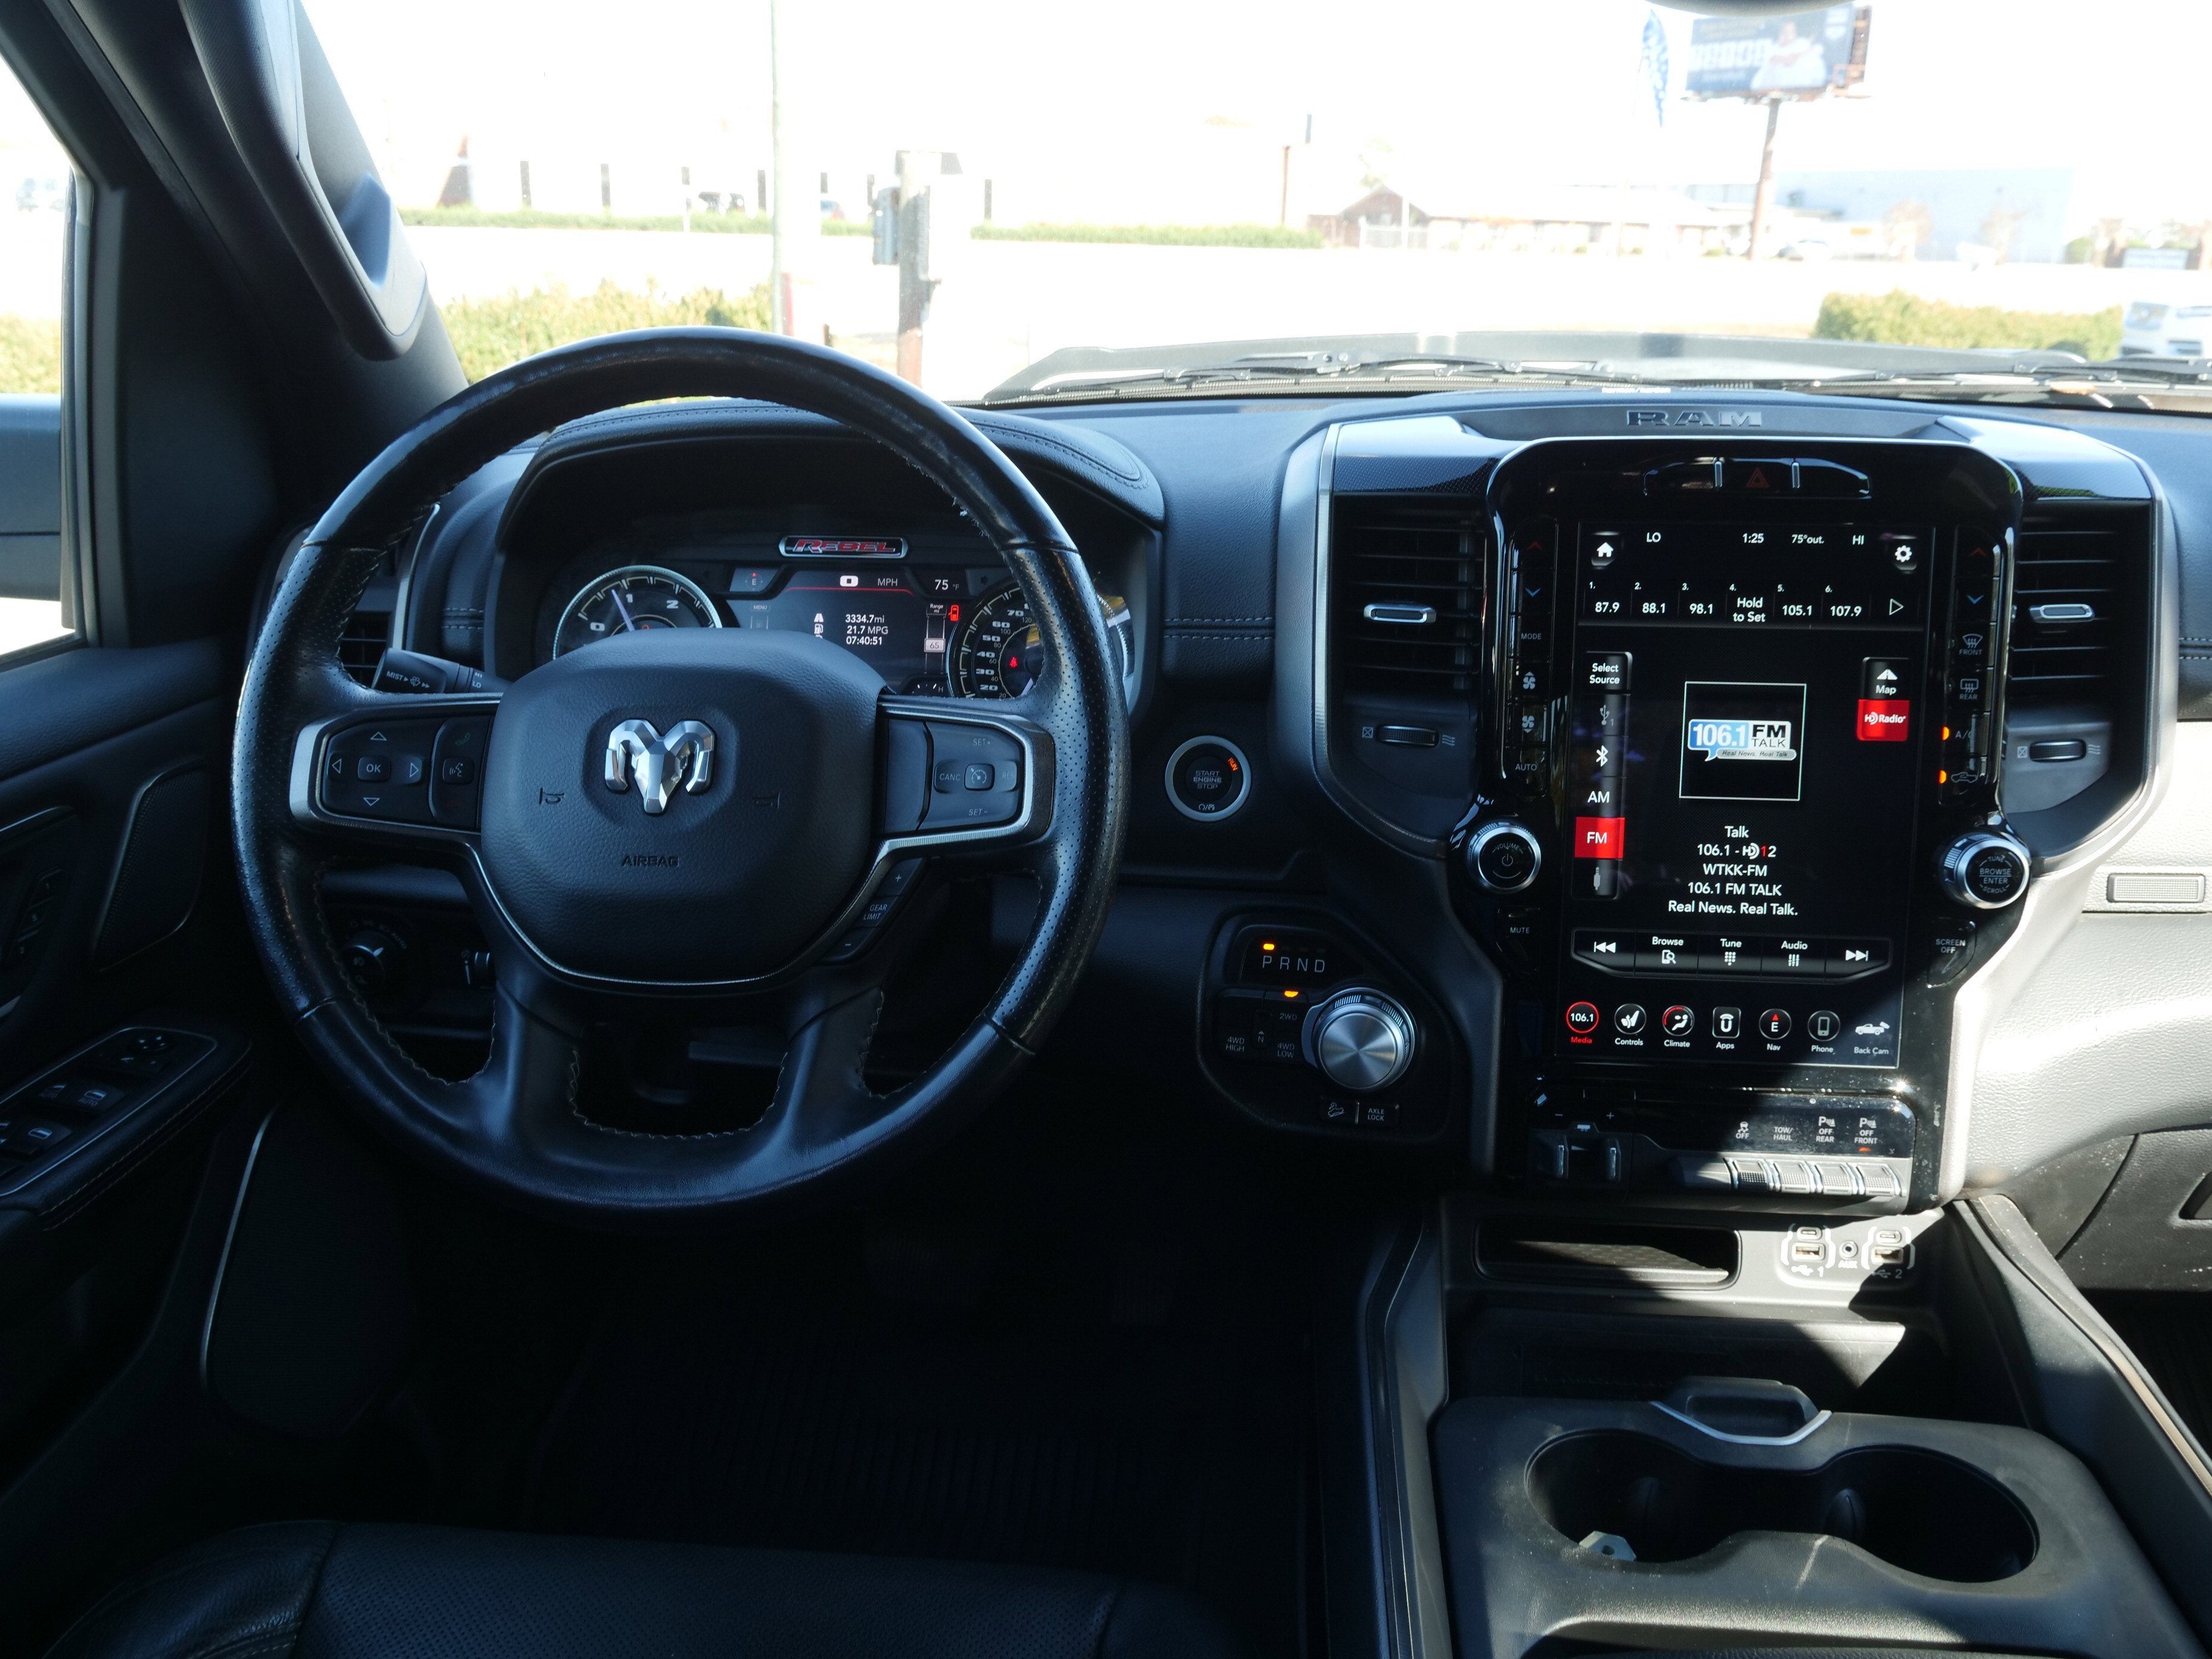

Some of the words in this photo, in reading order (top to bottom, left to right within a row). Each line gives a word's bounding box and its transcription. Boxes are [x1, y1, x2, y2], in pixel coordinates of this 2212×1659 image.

[1627, 410, 1762, 426] RAM
[1646, 532, 1661, 543] LO
[1742, 533, 1764, 543] 1:25
[1852, 535, 1865, 545] HI
[793, 539, 896, 554] REBEL
[877, 577, 898, 587] MPH
[934, 579, 949, 591] 75
[626, 594, 633, 603] 1
[1737, 597, 1763, 608] Hold
[666, 599, 679, 609] 2
[1595, 602, 1620, 613] 87.9
[1642, 602, 1666, 613] 88.1
[1689, 604, 1713, 614] 98.1
[1782, 605, 1812, 616] 105.1
[1830, 605, 1862, 617] 107.9
[1733, 612, 1745, 622] to
[1747, 611, 1766, 622] Set
[847, 626, 865, 634] 21.7
[867, 626, 888, 635] MPG
[846, 636, 883, 645] 07:40:51
[930, 641, 939, 650] 65
[1592, 663, 1619, 672] Select
[386, 670, 403, 681] MIST
[1589, 675, 1620, 684] Source
[1876, 685, 1896, 695] Map
[1610, 718, 1614, 726] 1
[1692, 723, 1747, 746] 106.1
[1752, 724, 1787, 738] FM
[1751, 738, 1786, 747] TALK
[366, 763, 381, 773] OK
[1228, 757, 1239, 771] RUN
[1587, 791, 1610, 803] AM
[1725, 825, 1750, 838] Talk
[1587, 831, 1607, 844] FM
[1496, 842, 1519, 851] VOLUME
[1697, 844, 1730, 856] 106.1
[621, 855, 679, 868] AIRBAG
[1703, 863, 1767, 877] WTKK-FM
[1688, 882, 1720, 894] 106.1
[1725, 883, 1745, 894] FM
[1749, 884, 1782, 896] TALK
[870, 903, 888, 912] GEAR
[1668, 900, 1695, 912] Real
[1698, 902, 1736, 914] News.
[1740, 902, 1767, 914] Real
[1770, 903, 1798, 915] Talk.
[1510, 926, 1530, 934] MUTE
[1652, 937, 1683, 946] Browse
[1720, 939, 1742, 948] Tune
[1781, 941, 1808, 950] Audio
[1936, 939, 1966, 947] SCREEN
[1262, 955, 1272, 968] P
[1279, 956, 1290, 970] R
[1297, 958, 1308, 971] N
[1314, 959, 1325, 973] D
[1570, 1012, 1594, 1023] 106.1
[1770, 1023, 1779, 1033] E
[1614, 1037, 1644, 1046] Controls
[1664, 1039, 1690, 1048] Climate
[1716, 1042, 1735, 1050] Apps
[1811, 1045, 1834, 1054] Phone
[1838, 1260, 1857, 1269] AUX
[1818, 1266, 1824, 1278] 1
[1894, 1269, 1902, 1279] 2
